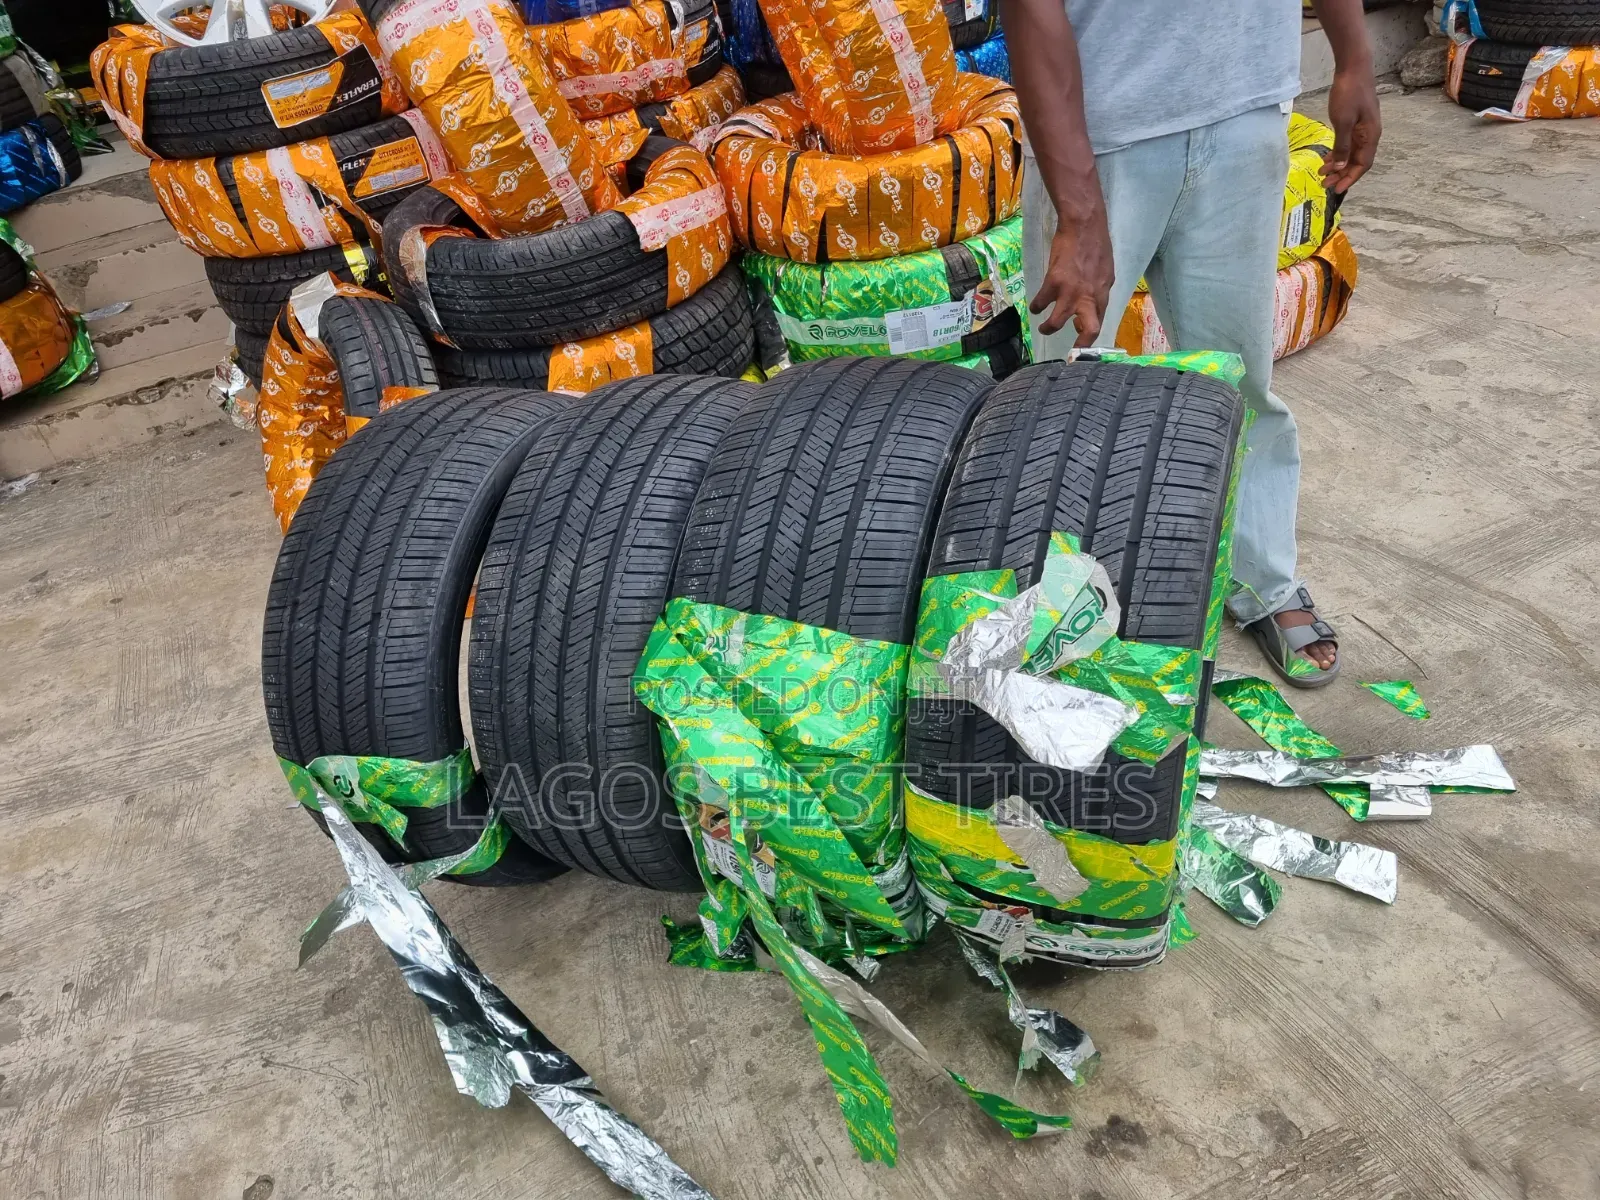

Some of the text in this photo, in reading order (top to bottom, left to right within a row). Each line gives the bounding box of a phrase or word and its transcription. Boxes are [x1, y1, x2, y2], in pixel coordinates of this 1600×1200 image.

[336, 76, 381, 104] TERAFLEX
[439, 92, 471, 136] TERAFLEX
[490, 160, 532, 198] TERAFLEX
[799, 167, 818, 216] TERAFLEX
[835, 168, 859, 216] TERAFLEX
[878, 166, 903, 213] TERAFLEX
[921, 162, 945, 208] TERAFLEX
[208, 212, 248, 249] TERAFLEX
[252, 208, 289, 249] TERAFLEX
[824, 325, 888, 339] ROVELO
[793, 827, 835, 838] ROVELO
[823, 871, 864, 884] ROVELO
[1100, 888, 1140, 911] ROVELO
